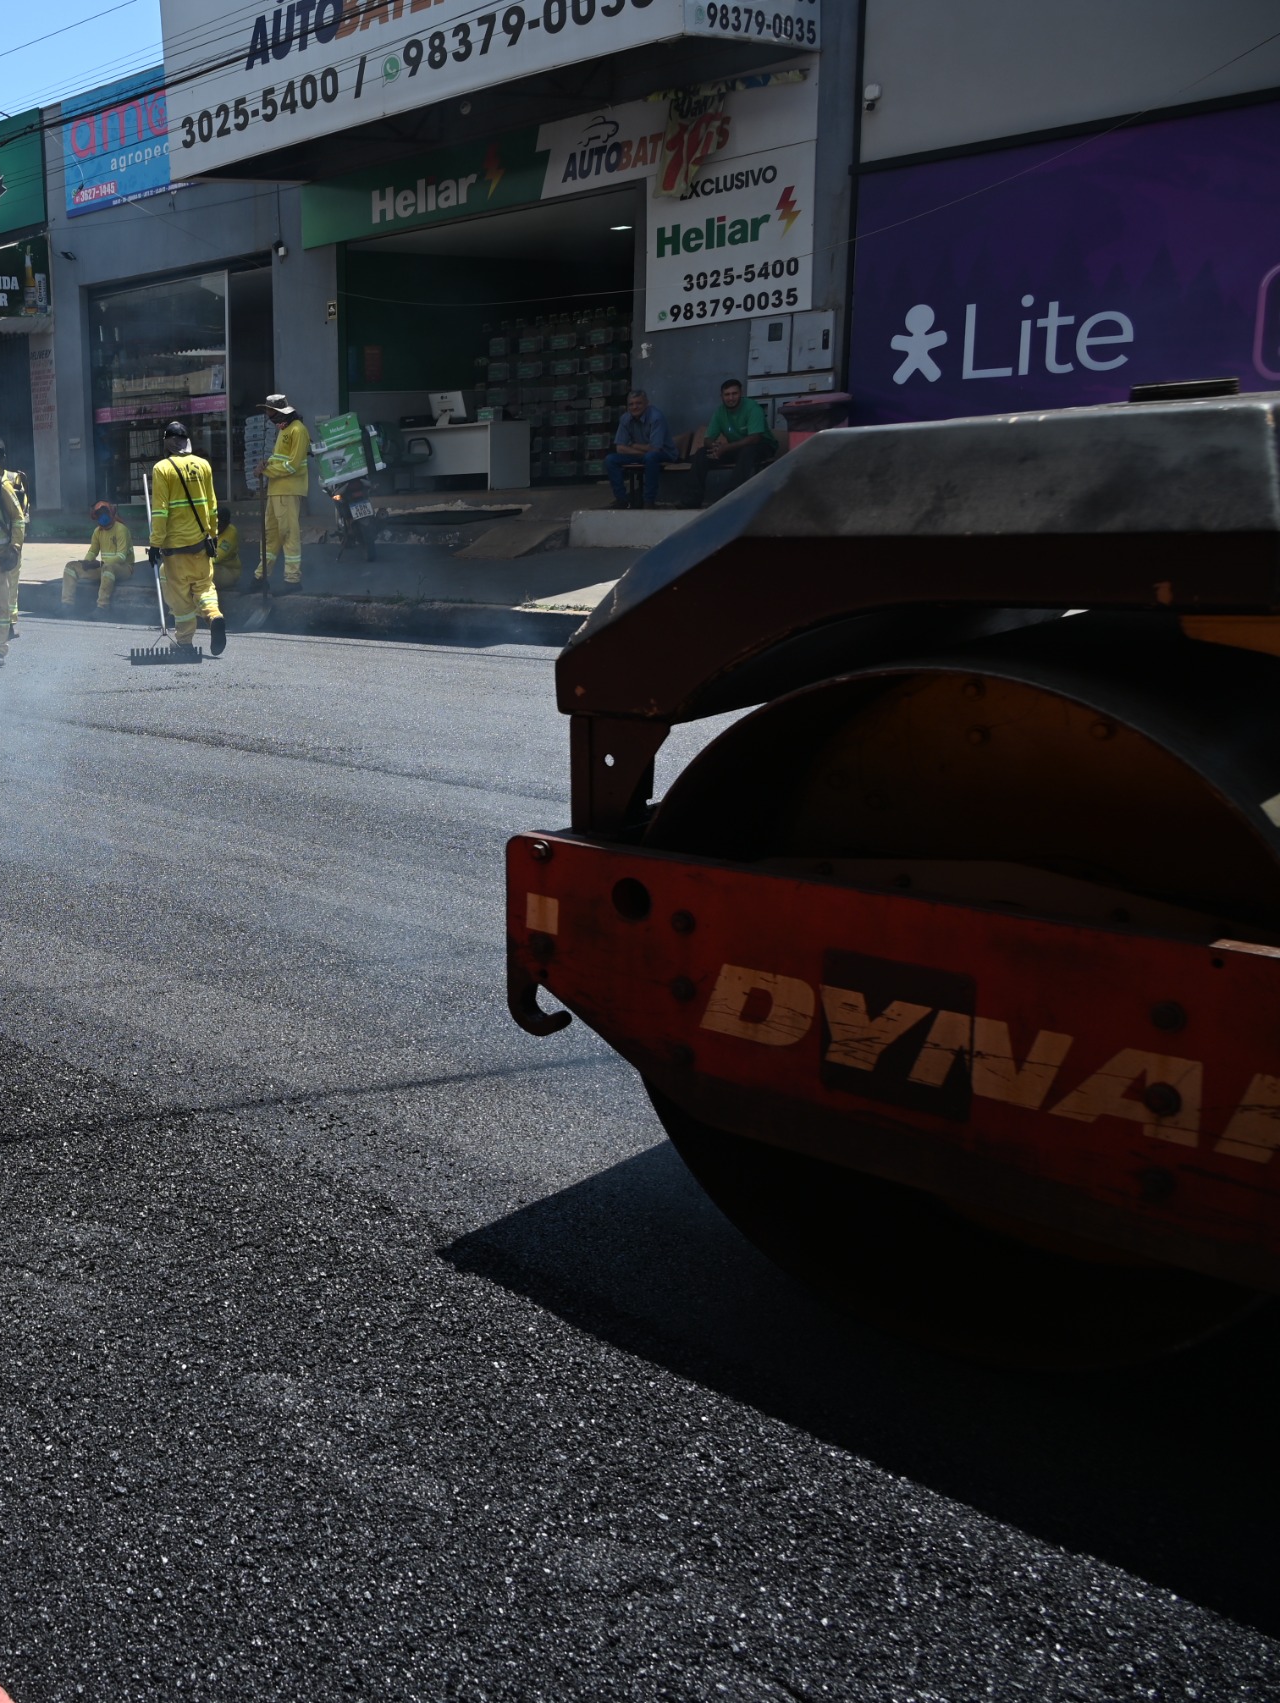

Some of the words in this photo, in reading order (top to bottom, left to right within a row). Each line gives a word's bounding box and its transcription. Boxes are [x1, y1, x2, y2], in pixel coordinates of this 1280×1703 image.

[707, 2, 817, 44] 98379-0035
[181, 67, 339, 148] 3025-5400
[403, 0, 655, 78] 98379-00
[371, 170, 477, 225] Heliar
[680, 165, 778, 201] XCLUSIVO
[656, 214, 771, 258] Heliar
[682, 257, 800, 292] 3025-5400
[669, 288, 799, 323] 98379-0035
[962, 295, 1135, 381] Lite
